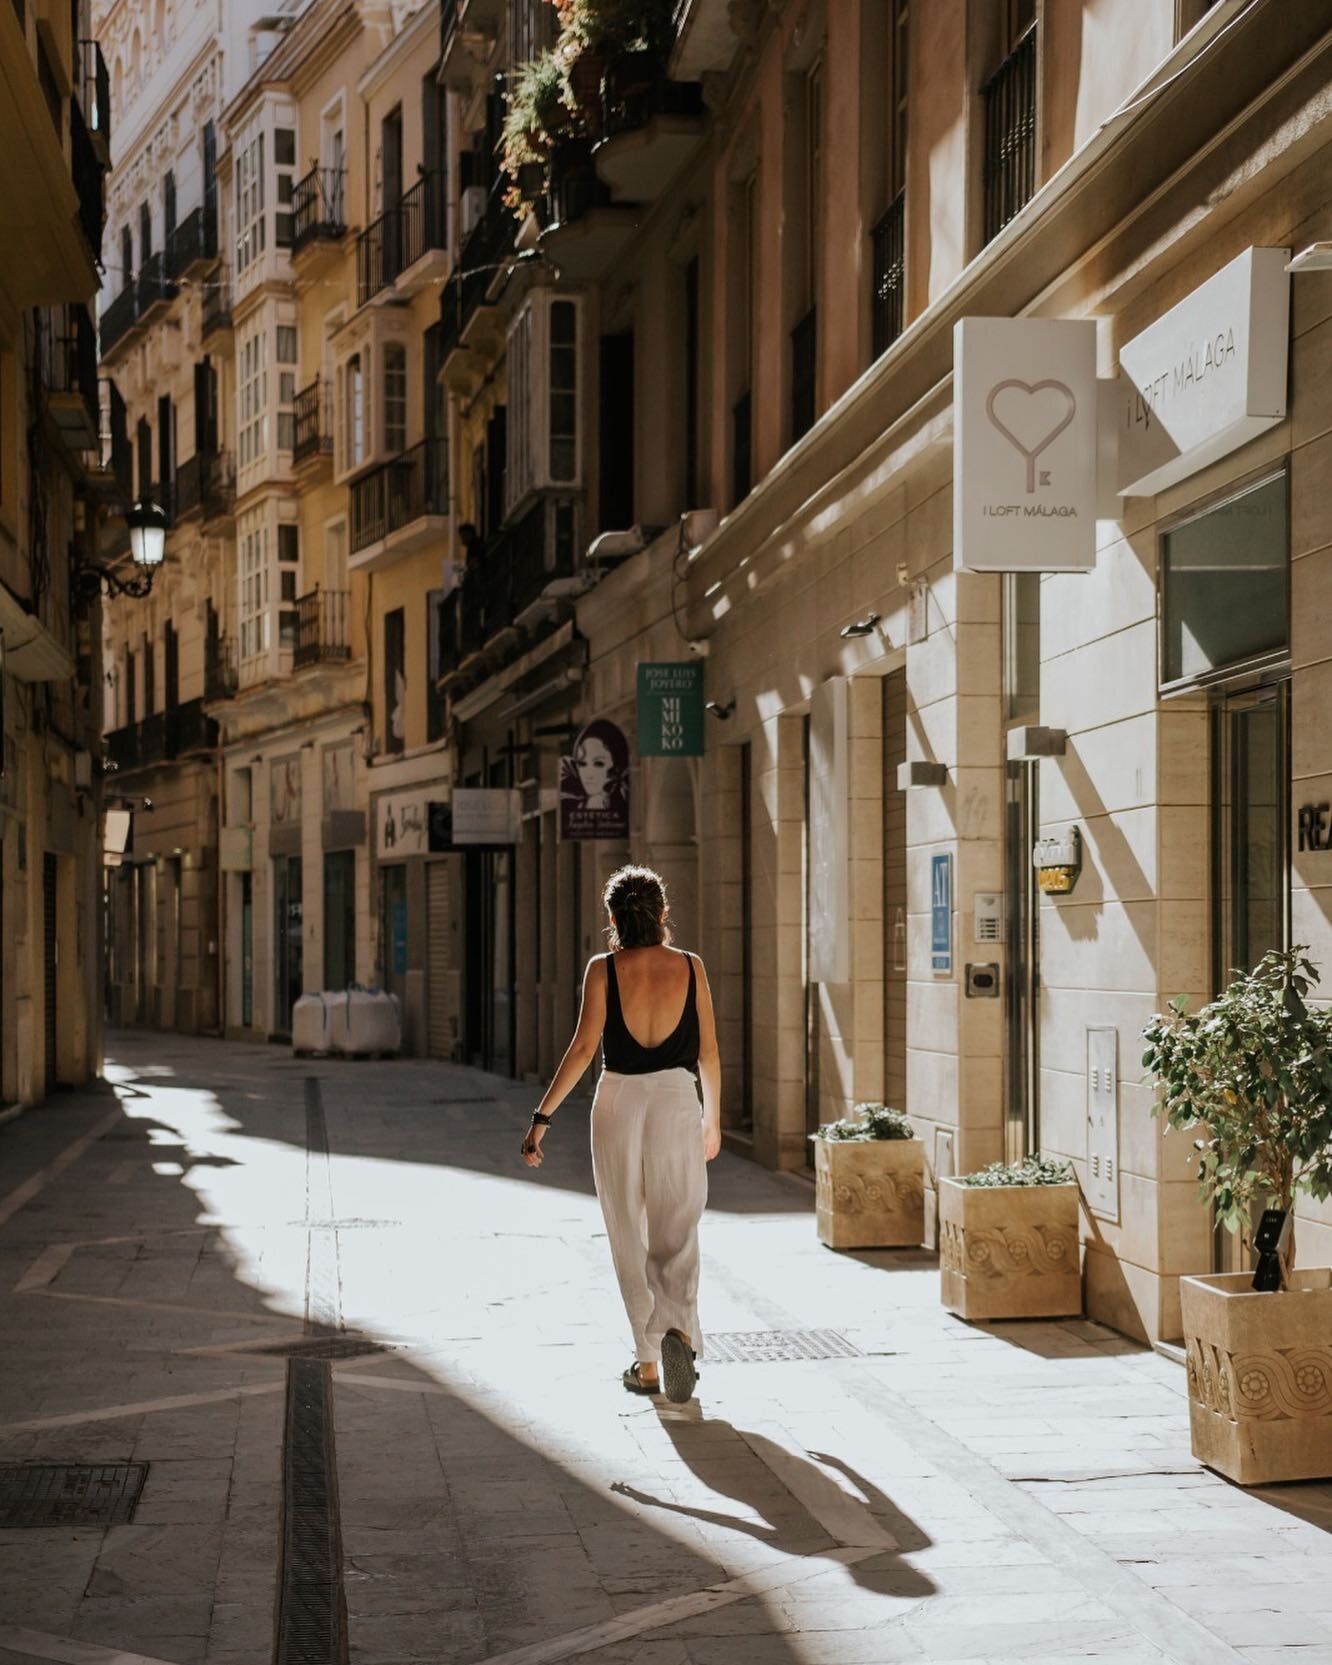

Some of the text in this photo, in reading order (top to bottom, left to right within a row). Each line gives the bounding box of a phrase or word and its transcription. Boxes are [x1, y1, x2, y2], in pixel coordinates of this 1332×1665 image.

[1136, 372, 1169, 429] LOFT
[989, 504, 1022, 517] LOFT
[1023, 503, 1078, 518] MÁLAGA
[661, 697, 681, 711] MI
[661, 710, 681, 724] MI
[661, 723, 684, 737] KO
[661, 737, 684, 751] KO
